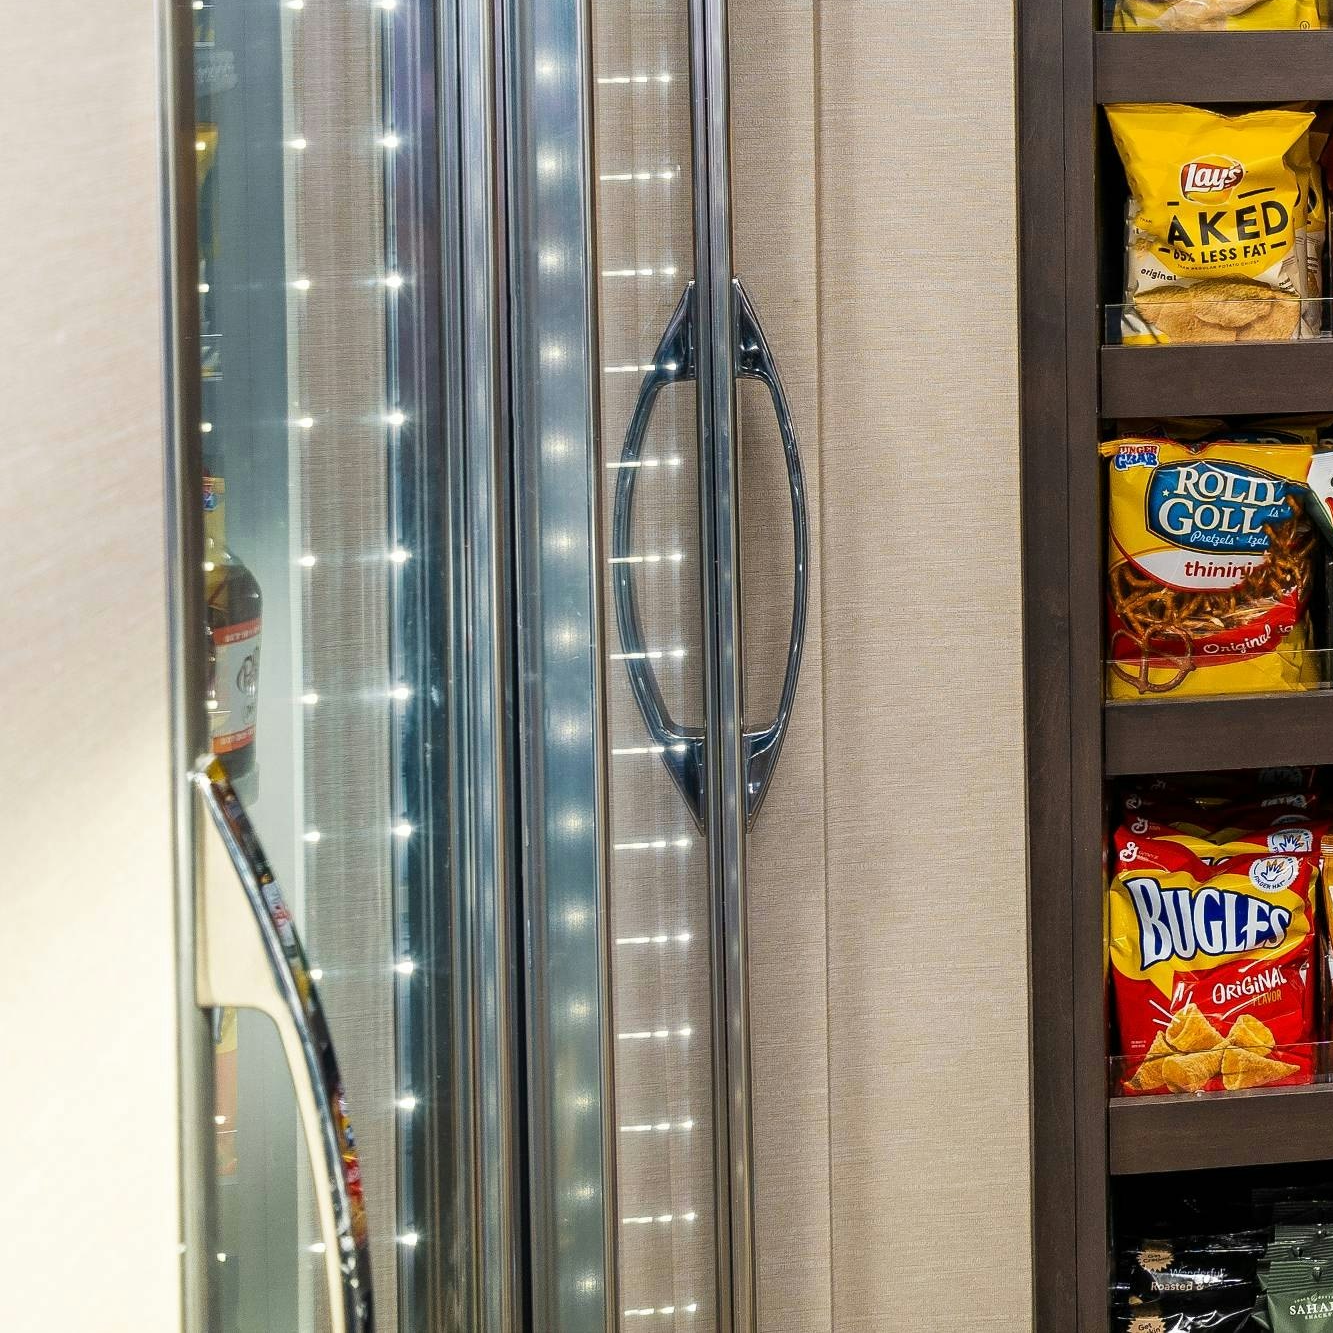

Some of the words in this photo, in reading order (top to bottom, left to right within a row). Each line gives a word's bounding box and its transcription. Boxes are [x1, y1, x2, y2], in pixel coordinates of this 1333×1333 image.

[1185, 161, 1243, 192] Lay's
[1201, 248, 1238, 263] LESS
[1243, 243, 1267, 259] FAT
[1141, 268, 1177, 281] original
[1203, 626, 1271, 655] Original
[1126, 878, 1290, 968] BUGLES
[1151, 1281, 1193, 1292] Roasted
